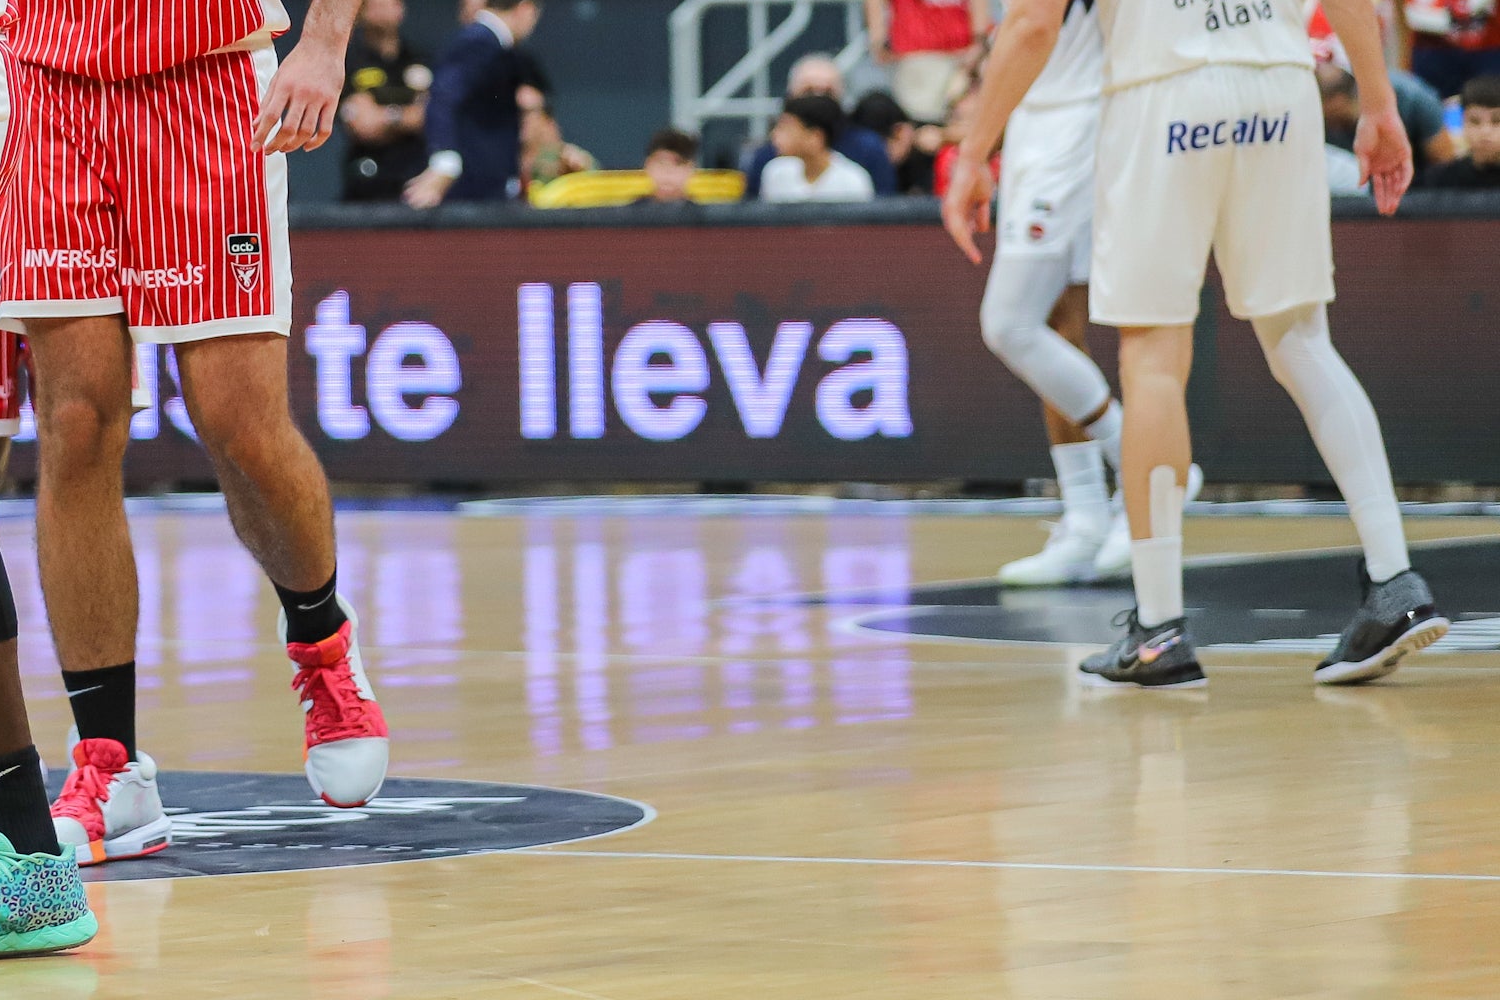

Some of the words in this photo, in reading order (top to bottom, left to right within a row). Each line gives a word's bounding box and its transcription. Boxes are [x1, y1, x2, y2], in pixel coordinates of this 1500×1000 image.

[1167, 112, 1291, 153] Recalvi
[24, 244, 116, 269] INVERSUS
[231, 241, 254, 252] acb
[305, 290, 462, 441] te
[516, 282, 913, 441] lleva
